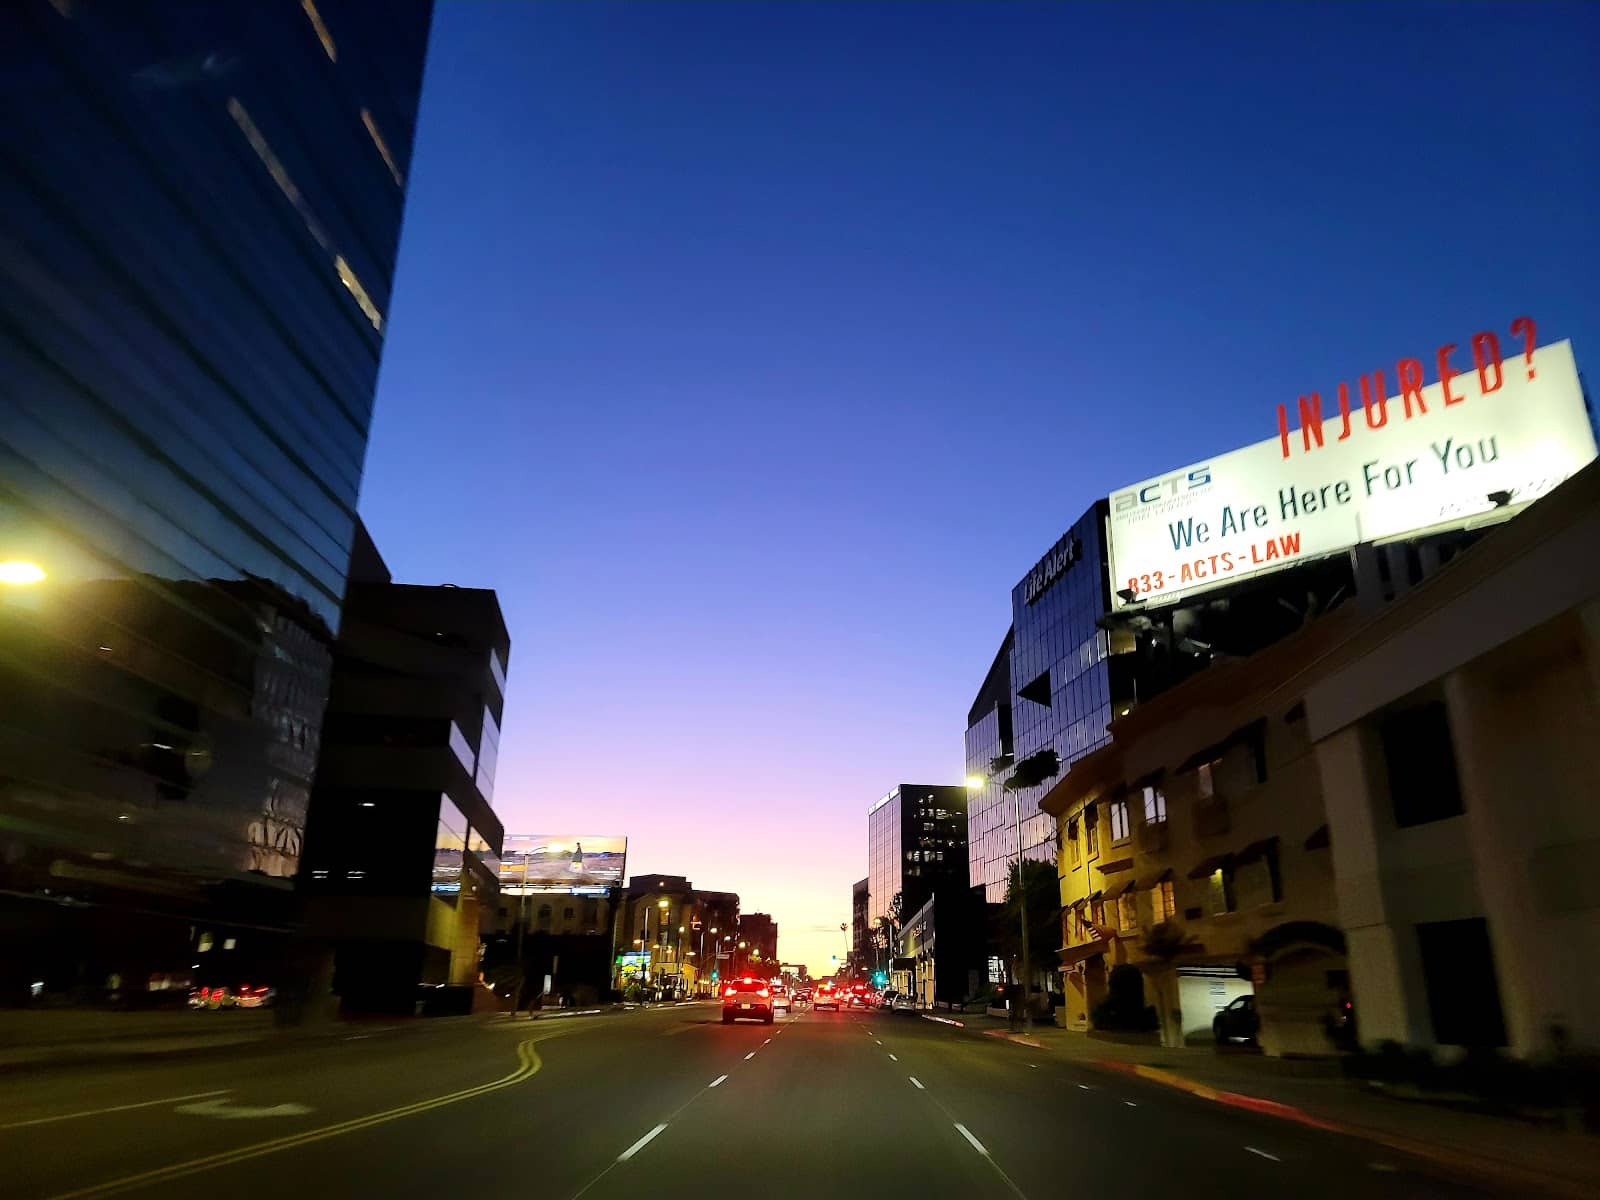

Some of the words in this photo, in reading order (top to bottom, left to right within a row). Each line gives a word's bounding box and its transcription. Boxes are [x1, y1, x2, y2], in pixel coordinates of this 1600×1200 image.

[1276, 316, 1539, 459] INJURED?
[1168, 519, 1210, 552] We
[1221, 503, 1269, 539] Are
[1278, 479, 1352, 522] Here
[1362, 458, 1419, 499] For
[1432, 434, 1500, 476] You
[1024, 572, 1043, 605] Life
[1044, 540, 1075, 584] Alert
